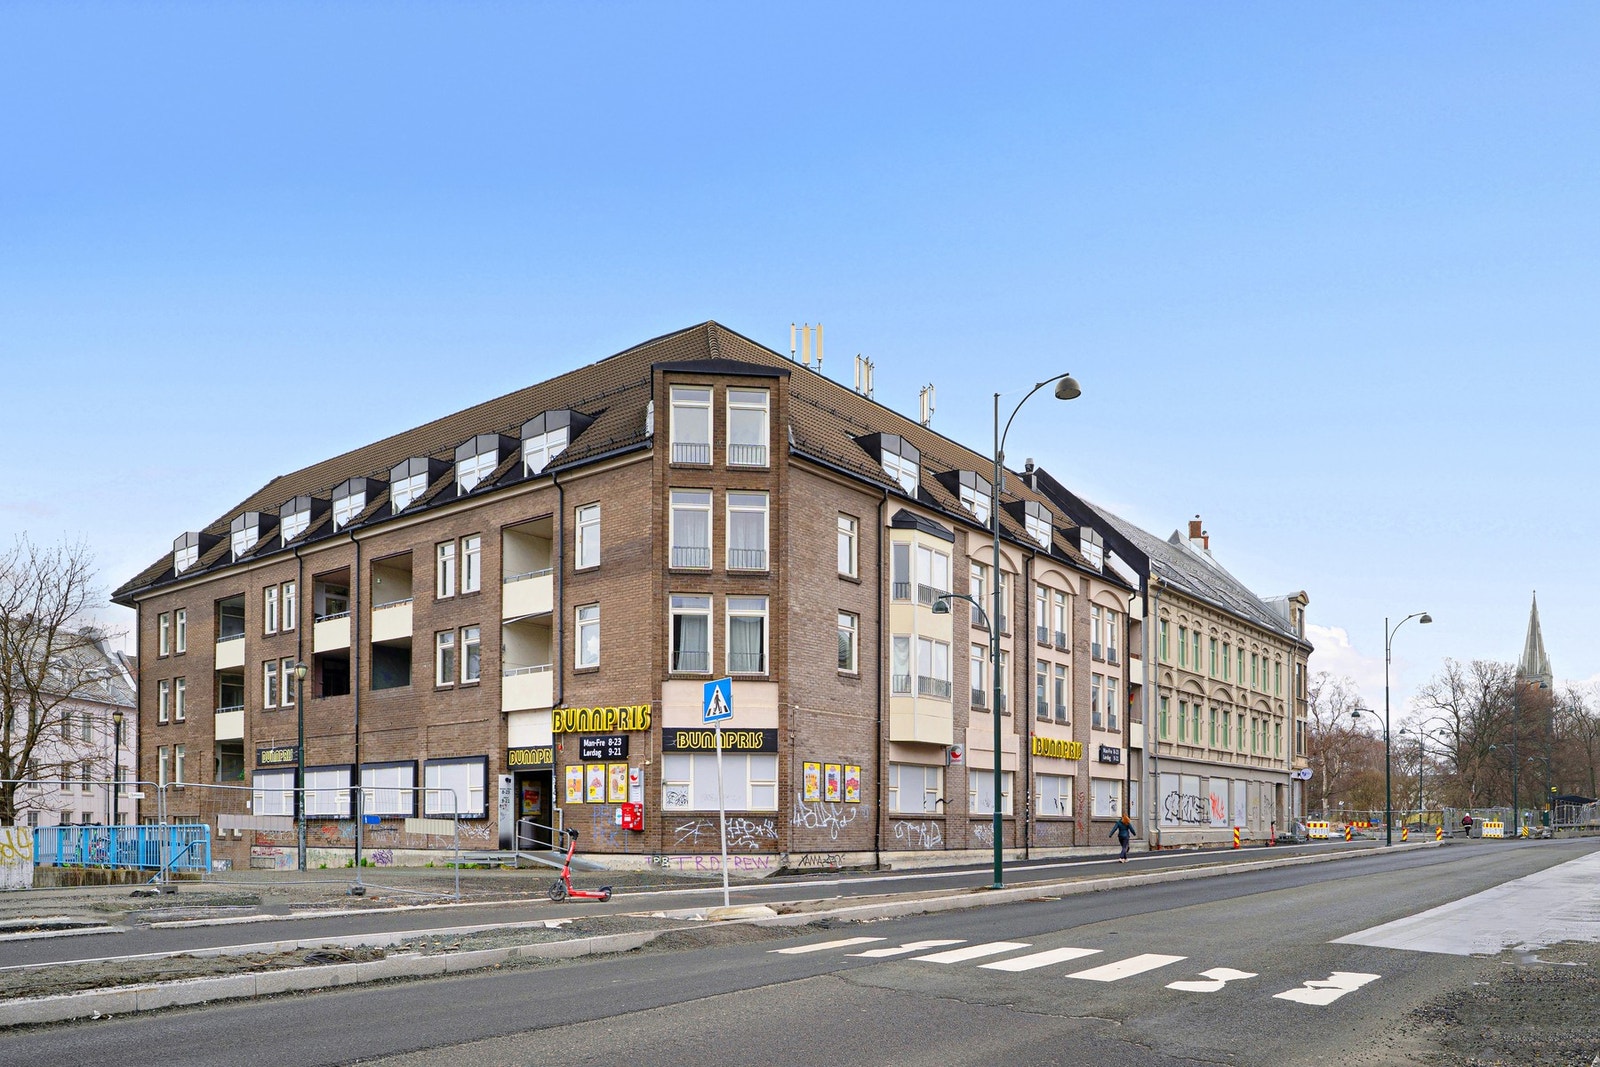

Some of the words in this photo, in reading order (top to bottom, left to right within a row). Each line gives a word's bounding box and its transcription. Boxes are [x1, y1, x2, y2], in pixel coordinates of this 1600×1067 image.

[552, 705, 651, 732] BUNNPRIS
[583, 738, 606, 747] Man-Fre
[608, 737, 622, 746] 8-23
[608, 747, 622, 756] 9-21
